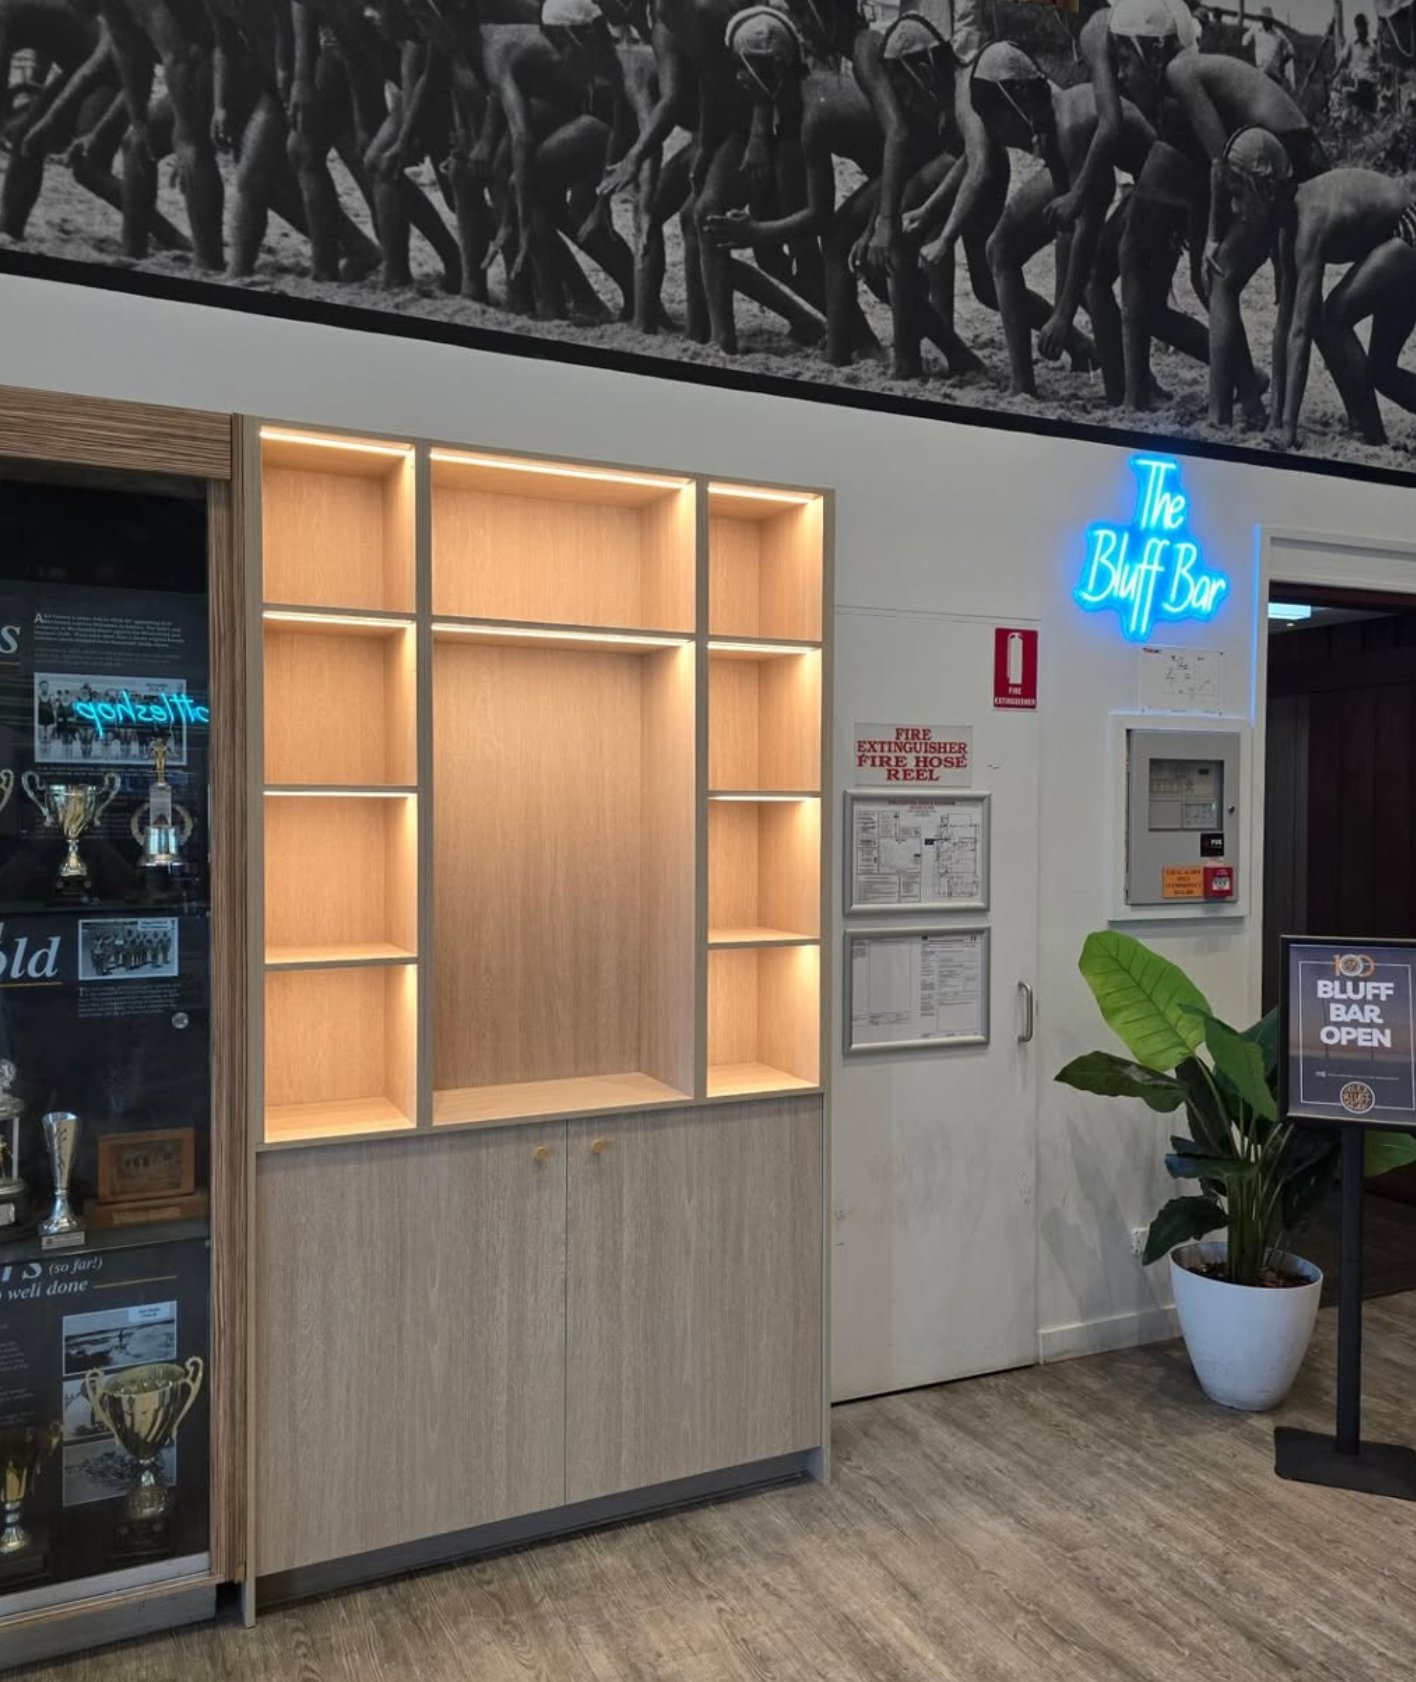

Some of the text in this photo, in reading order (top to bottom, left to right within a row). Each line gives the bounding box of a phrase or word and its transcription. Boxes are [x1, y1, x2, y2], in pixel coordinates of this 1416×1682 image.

[1134, 458, 1186, 530] The
[1080, 529, 1226, 635] Bluff Bar
[1008, 687, 1022, 695] FIRE
[895, 728, 932, 741] FIRE
[857, 741, 968, 755] EXTINGUISHER
[857, 754, 968, 768] FIRE HOSE
[886, 769, 940, 782] REEL
[0, 936, 61, 978] ld
[1316, 980, 1394, 1001] BLUFF
[1329, 1002, 1384, 1024] BAR
[1319, 1025, 1393, 1048] OPEN
[48, 1262, 70, 1277] (so
[70, 1255, 104, 1275] far!)
[7, 1279, 89, 1301] well done
